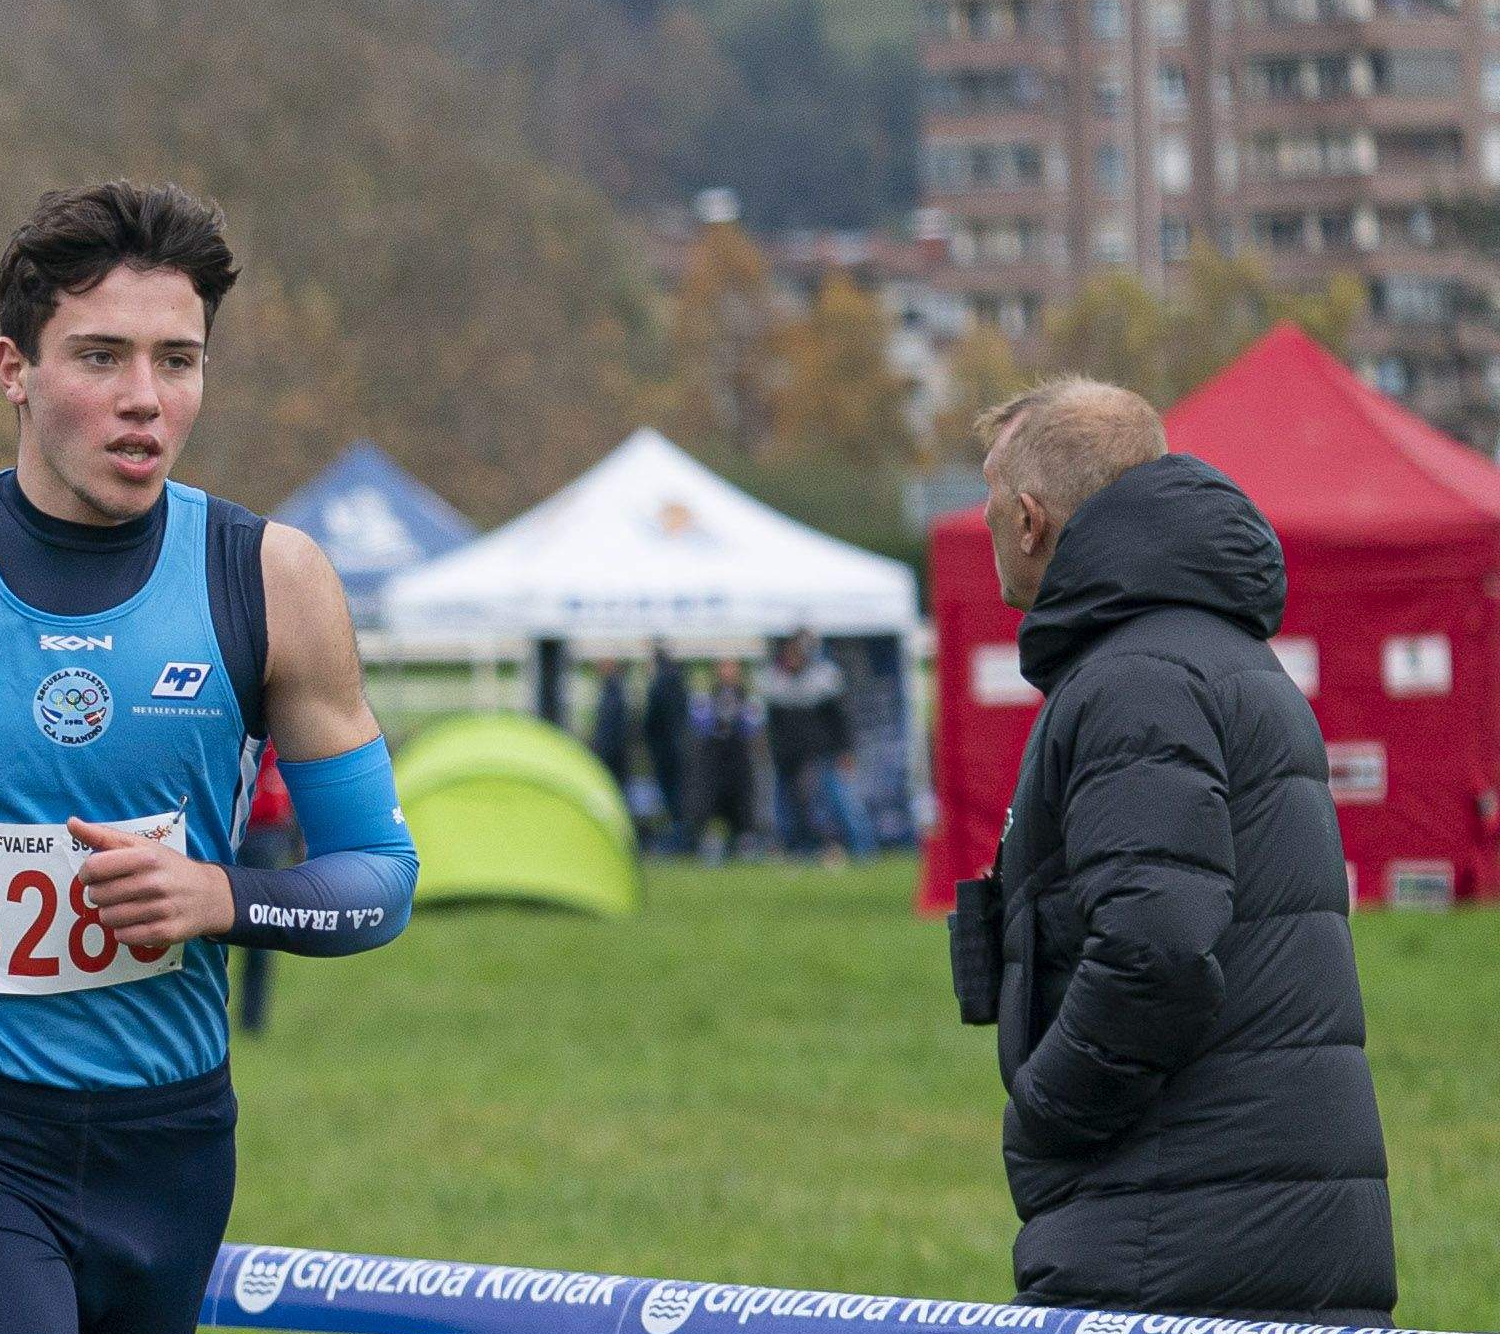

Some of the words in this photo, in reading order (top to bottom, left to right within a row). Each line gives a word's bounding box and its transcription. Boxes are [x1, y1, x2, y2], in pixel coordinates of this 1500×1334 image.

[39, 634, 113, 651] KON
[37, 670, 70, 702] ESCUELA
[163, 667, 201, 691] MP
[132, 706, 176, 715] METALES
[43, 724, 59, 740] C.A.
[61, 725, 103, 744] ERANDIO
[71, 837, 94, 853] SU
[249, 903, 340, 931] ERANDIO
[345, 906, 385, 929] C.A.
[291, 1251, 476, 1301] Gipuzkoa
[476, 1264, 627, 1305] Kirolak
[703, 1284, 899, 1325] Gipuzkoa
